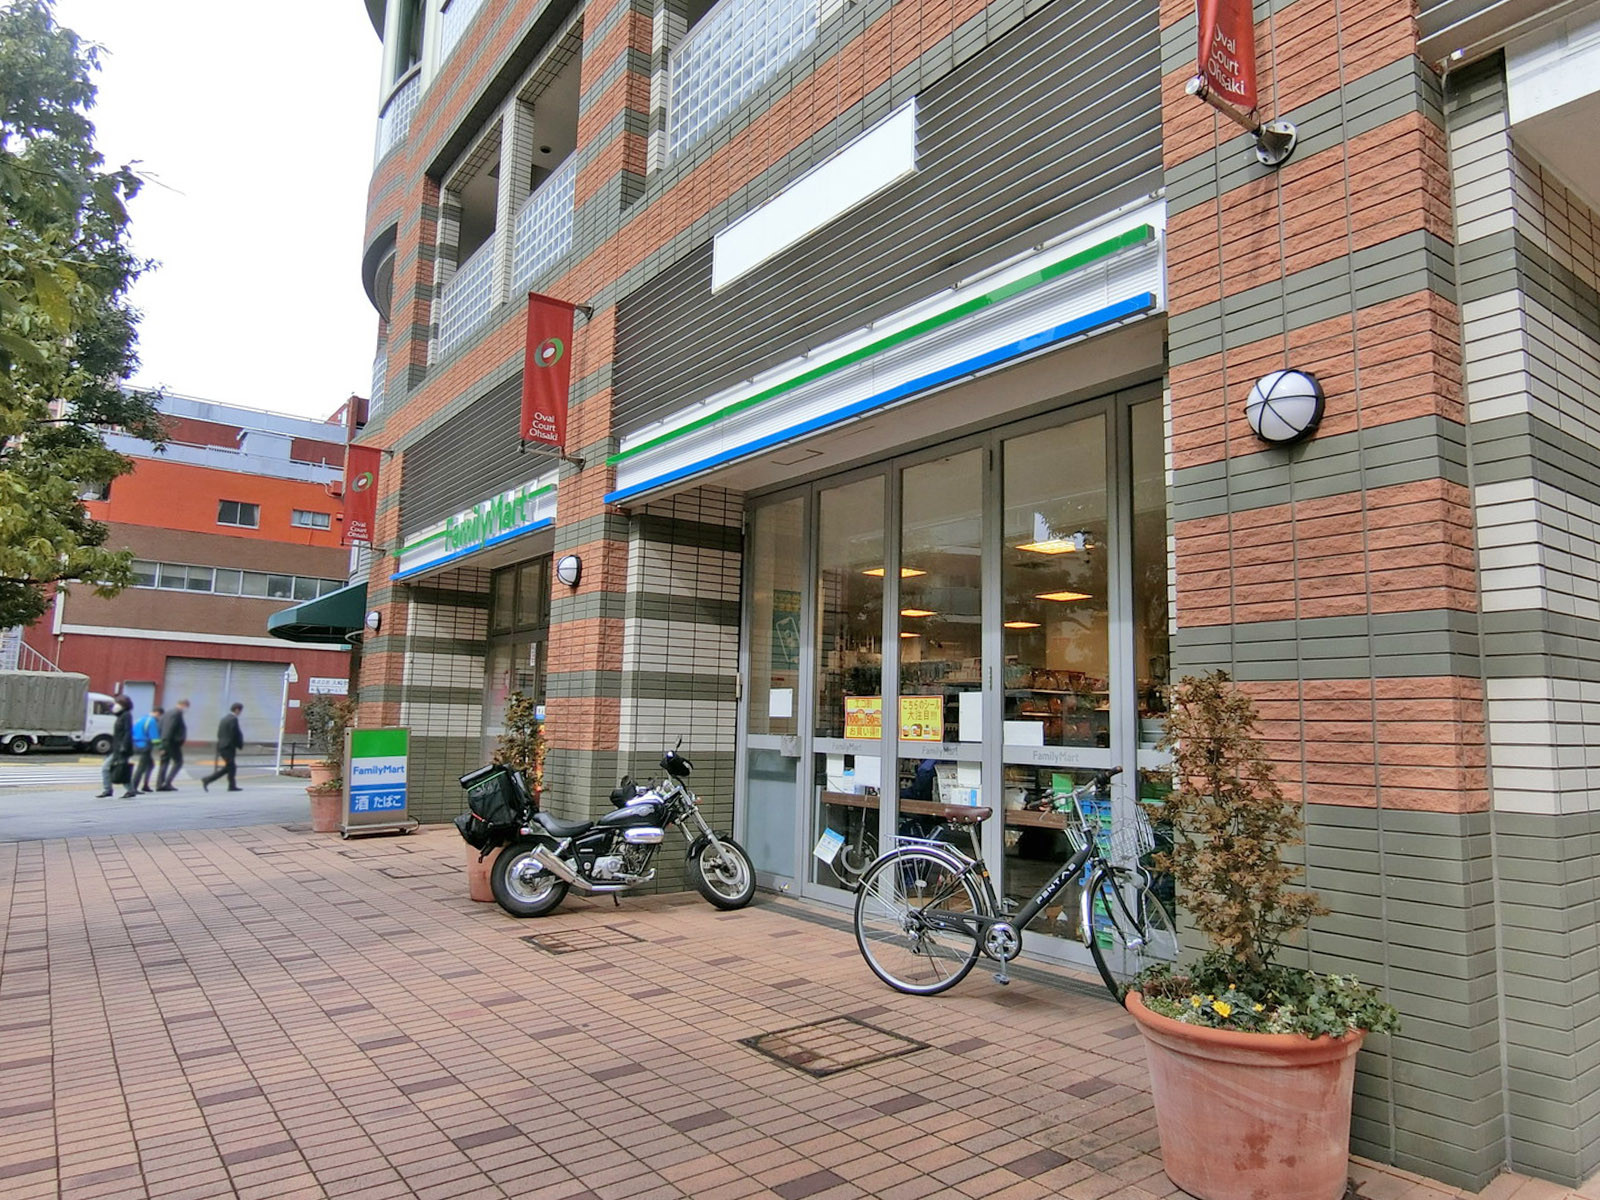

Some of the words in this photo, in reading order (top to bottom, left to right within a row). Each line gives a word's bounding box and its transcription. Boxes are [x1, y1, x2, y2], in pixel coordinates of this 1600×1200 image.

[1211, 41, 1239, 76] Court
[1207, 58, 1245, 95] Ohsaki
[534, 411, 555, 423] Oval
[532, 419, 556, 432] Court
[529, 428, 558, 441] Ohsaki
[445, 485, 527, 552] FamilyMart
[922, 746, 958, 756] FamilyMart
[1032, 751, 1080, 763] FamilyMart
[353, 765, 405, 775] FamilyMart
[355, 795, 370, 811] 酒
[373, 795, 402, 808] たばこ
